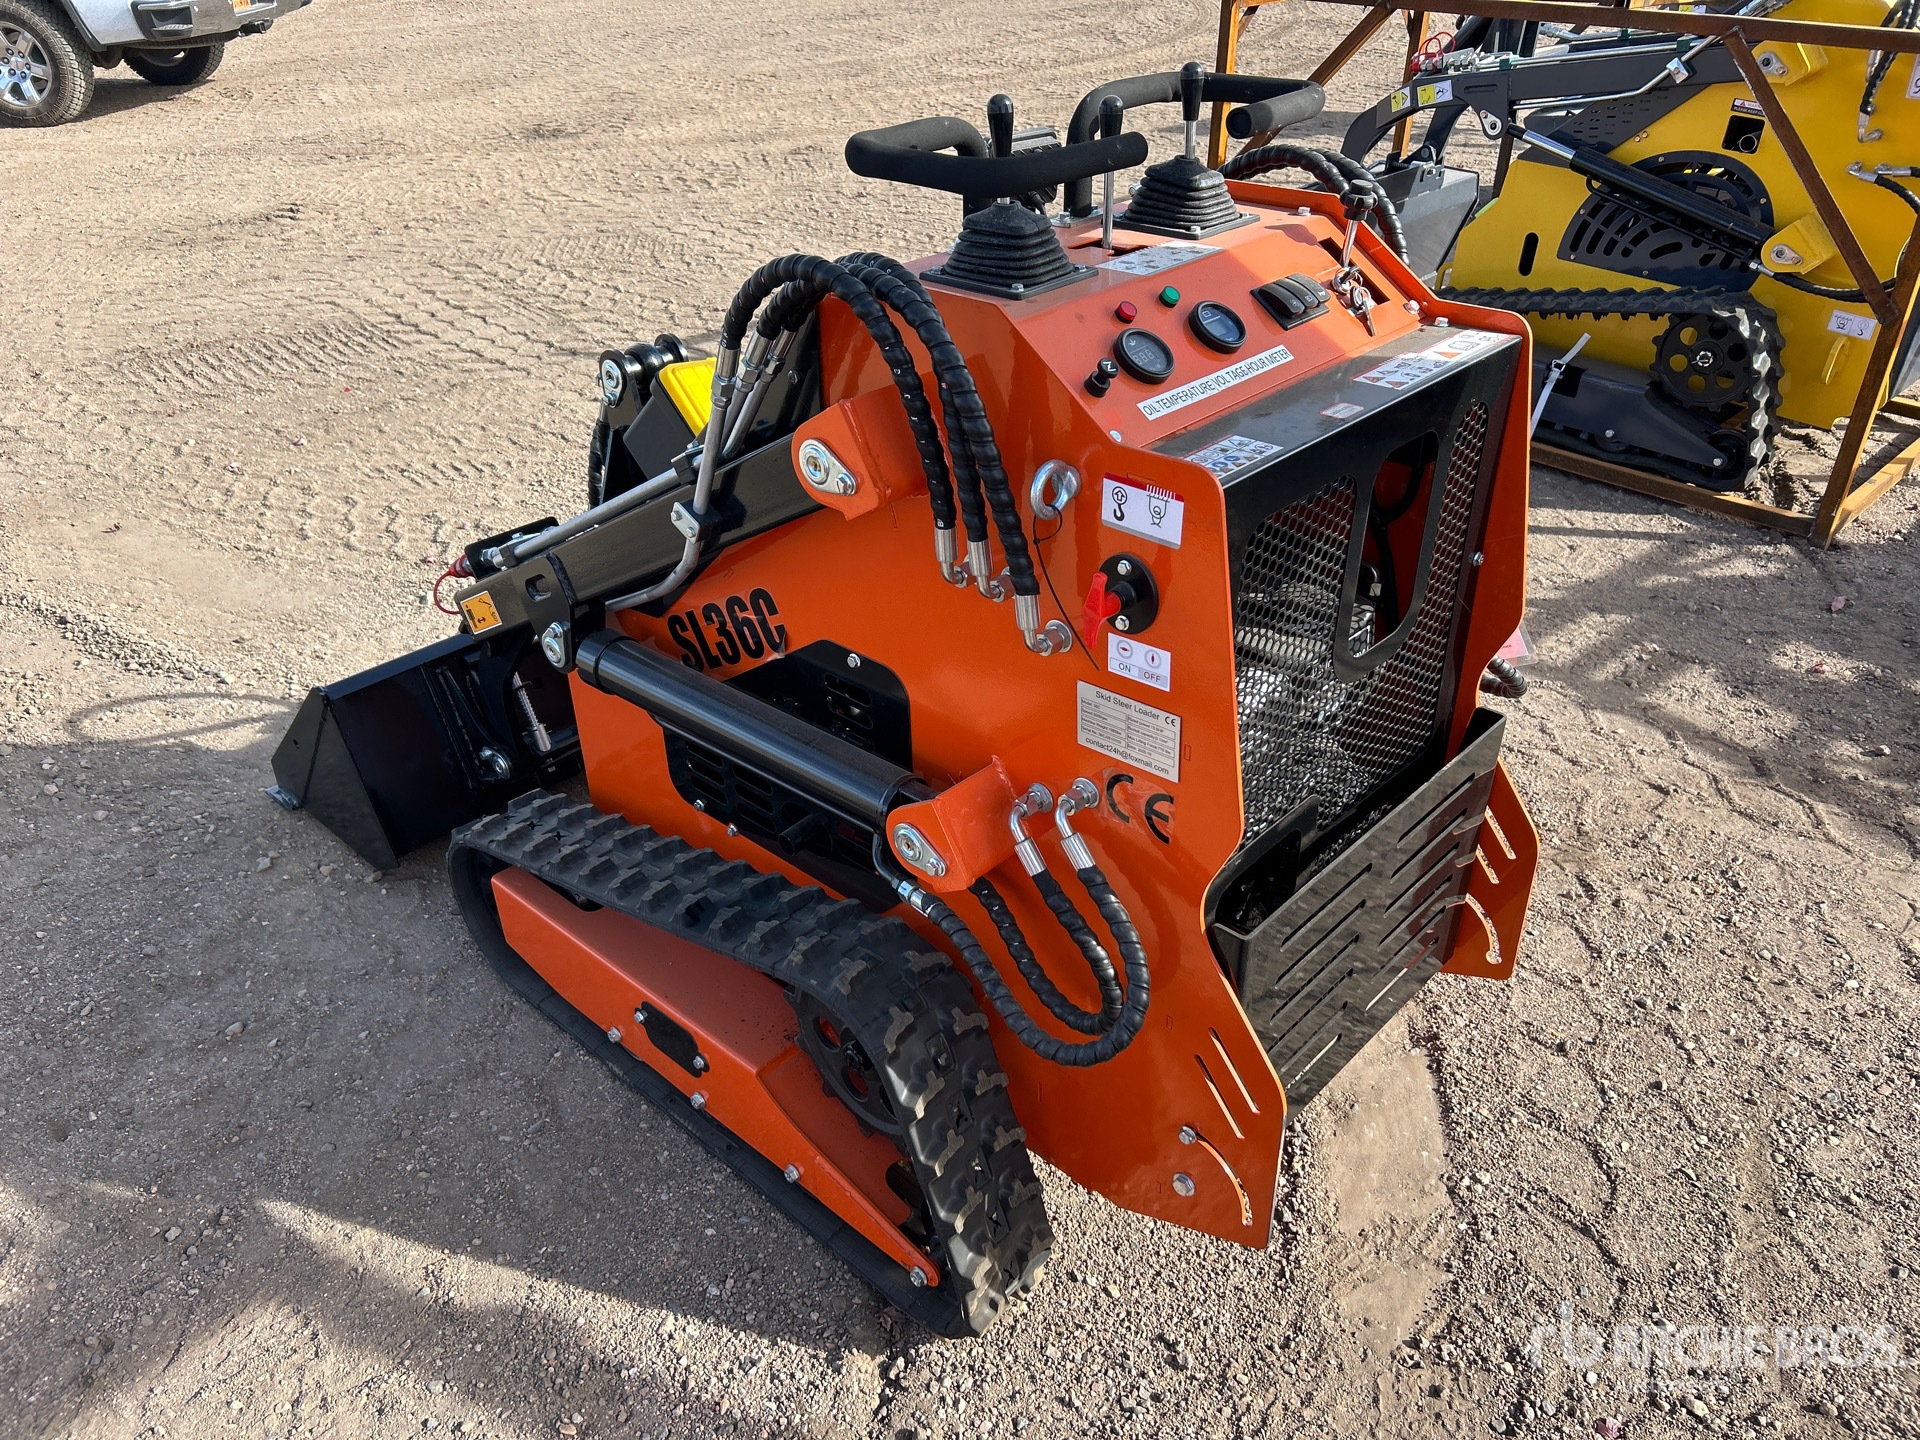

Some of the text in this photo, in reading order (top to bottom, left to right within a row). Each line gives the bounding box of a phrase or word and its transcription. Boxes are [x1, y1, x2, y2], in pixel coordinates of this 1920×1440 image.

[1142, 348, 1292, 416] OIL TEMPERATURE VOLTAGE HOUR METER
[667, 587, 786, 673] SL36C
[1118, 662, 1161, 683] ON OFF
[1096, 691, 1110, 702] Skid
[1113, 697, 1132, 709] Steer
[1134, 704, 1160, 720] Loader
[1086, 737, 1169, 775] contact24h@foxmail.com
[1107, 774, 1174, 845] CE
